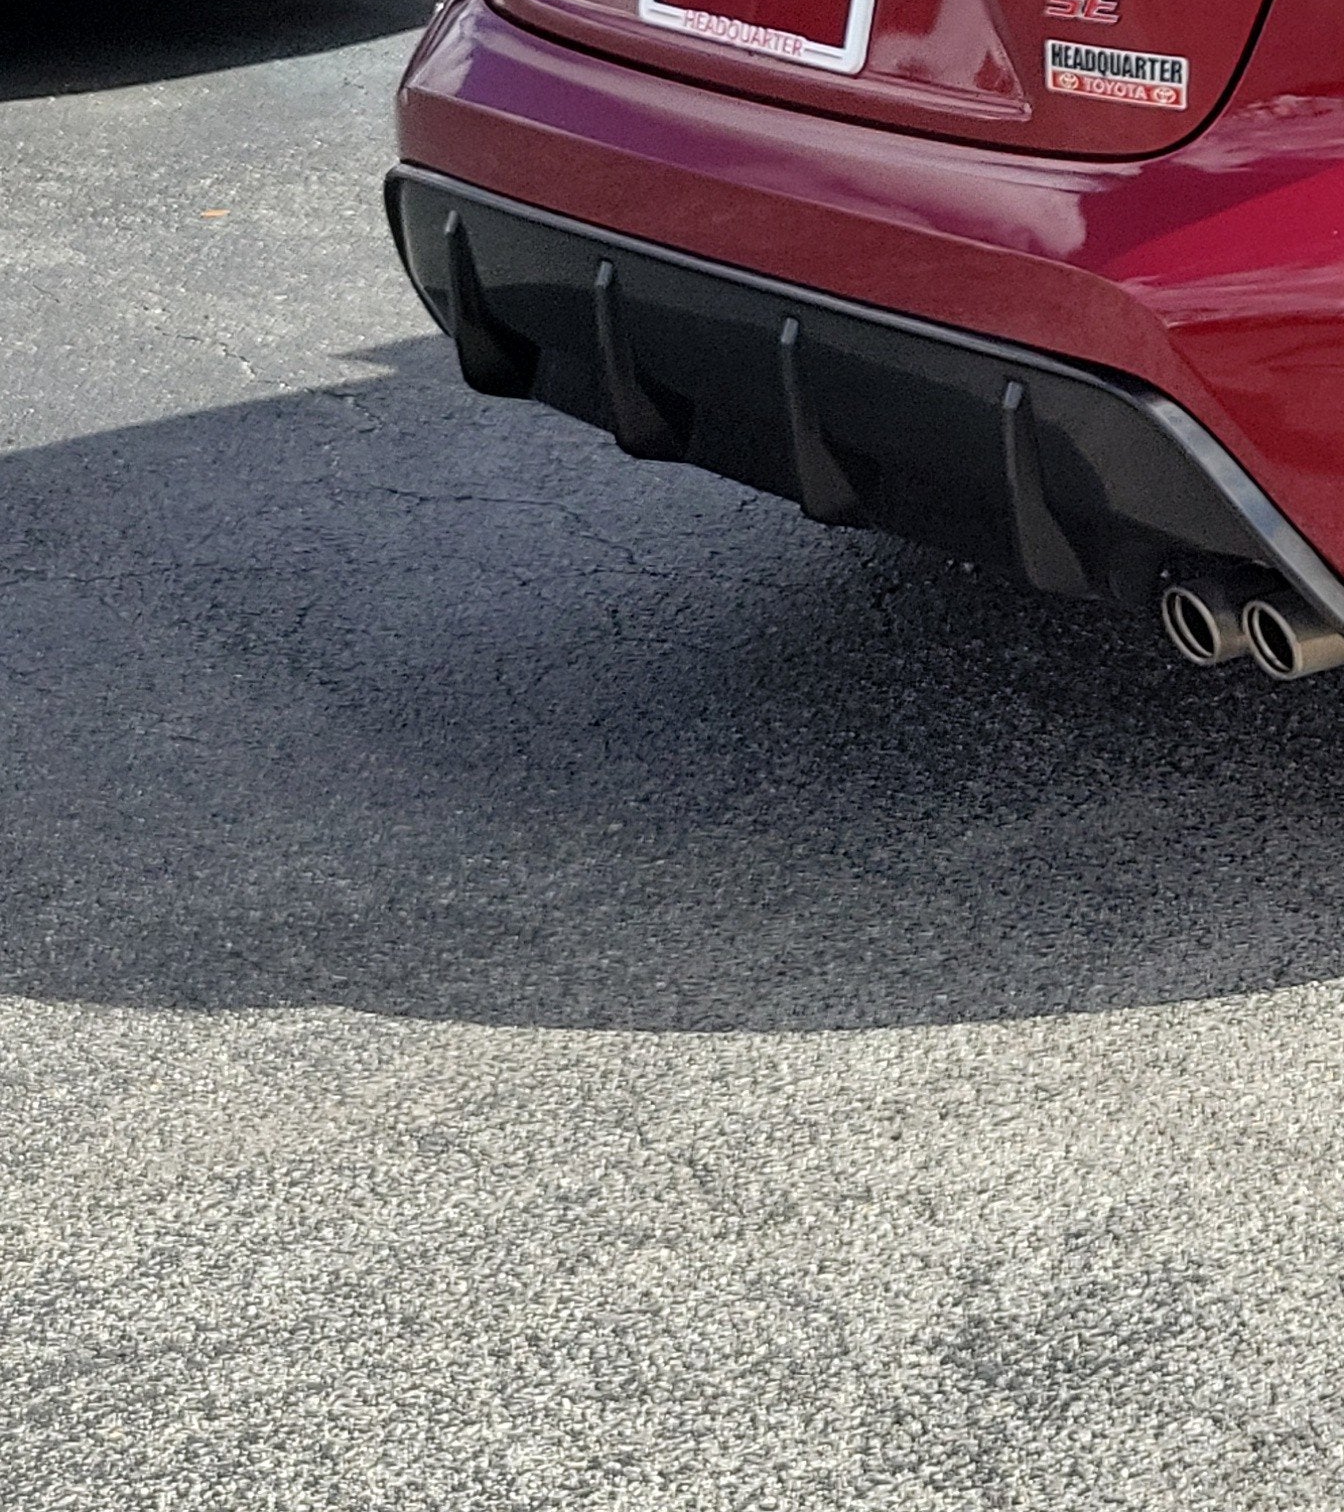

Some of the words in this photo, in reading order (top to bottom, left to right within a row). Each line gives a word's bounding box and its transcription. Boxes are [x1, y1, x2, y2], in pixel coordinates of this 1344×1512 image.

[683, 10, 803, 55] HEADQUARTER
[1051, 43, 1182, 84] HEADQUARTER
[1084, 78, 1148, 99] TOYOTA
